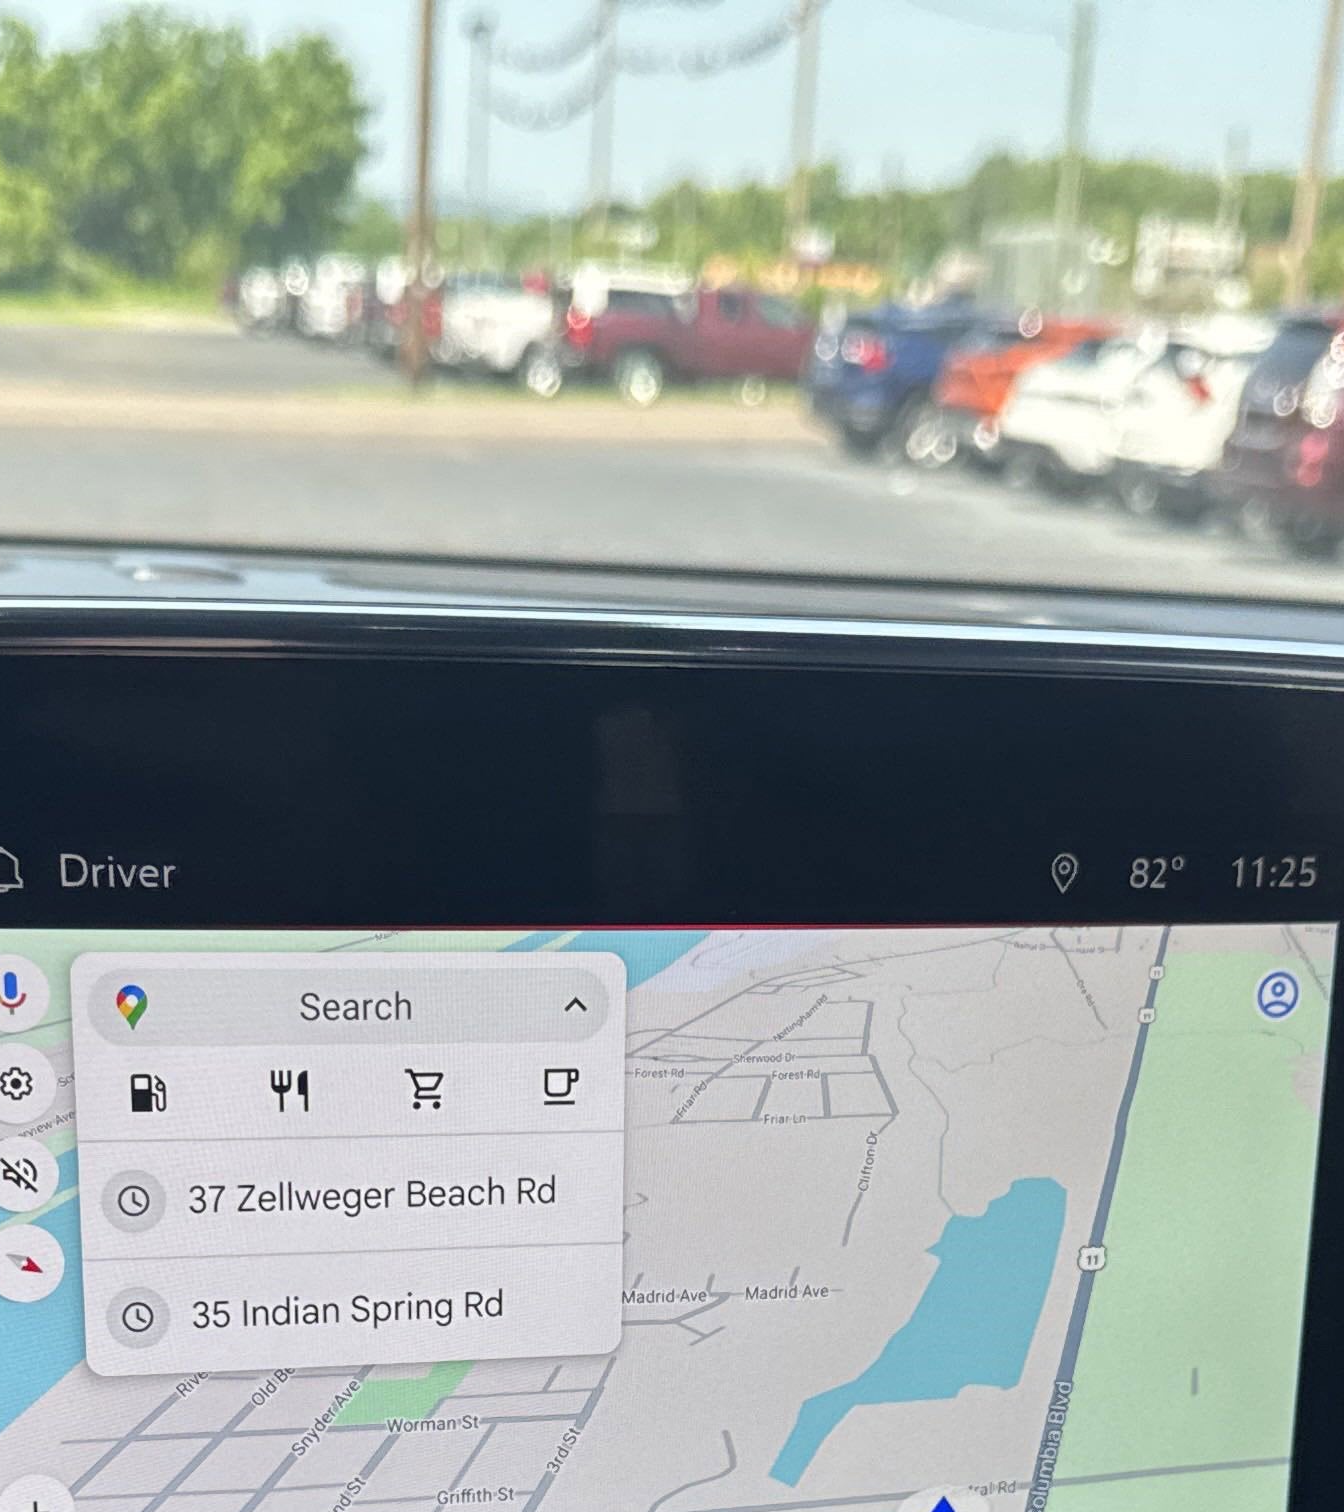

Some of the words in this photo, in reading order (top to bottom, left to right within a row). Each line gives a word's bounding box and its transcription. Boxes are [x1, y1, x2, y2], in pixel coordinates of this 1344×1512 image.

[59, 852, 176, 889] Driver
[1232, 857, 1318, 888] 11:25
[300, 991, 412, 1022] Search
[773, 1002, 819, 1042] Nottingham
[734, 1054, 781, 1063] Sherwood
[783, 1053, 796, 1063] Dr
[634, 1068, 670, 1079] Forest
[671, 1068, 685, 1079] Rd
[772, 1069, 805, 1080] Forest
[807, 1069, 820, 1080] Rd
[676, 1094, 695, 1119] Friar
[692, 1080, 707, 1097] Rd
[763, 1113, 791, 1124] Friar
[792, 1113, 806, 1123] Ln
[857, 1149, 875, 1192] Clifton
[866, 1130, 878, 1146] Dr
[189, 1185, 225, 1214] 37
[237, 1181, 394, 1219] Zellweger
[407, 1177, 505, 1208] Beach
[517, 1175, 556, 1205] Rd
[1086, 1254, 1099, 1266] 11
[622, 1290, 674, 1304] Madrid
[680, 1290, 707, 1303] Ave
[745, 1285, 797, 1300] Madrid
[802, 1285, 829, 1298] Ave
[192, 1300, 230, 1329] 35
[243, 1294, 340, 1327] Indian
[352, 1291, 453, 1329] Spring
[465, 1289, 504, 1319] Rd
[251, 1380, 277, 1407] Old
[1047, 1381, 1072, 1426] Blvd
[291, 1407, 336, 1457] Snyder
[335, 1379, 361, 1408] Ave
[387, 1418, 457, 1433] Worman
[462, 1415, 479, 1430] St
[546, 1445, 570, 1473] 3rd
[563, 1427, 581, 1446] St
[346, 1477, 366, 1496] St
[437, 1489, 492, 1505] Griffith
[498, 1487, 514, 1501] St
[998, 1480, 1016, 1494] Rd
